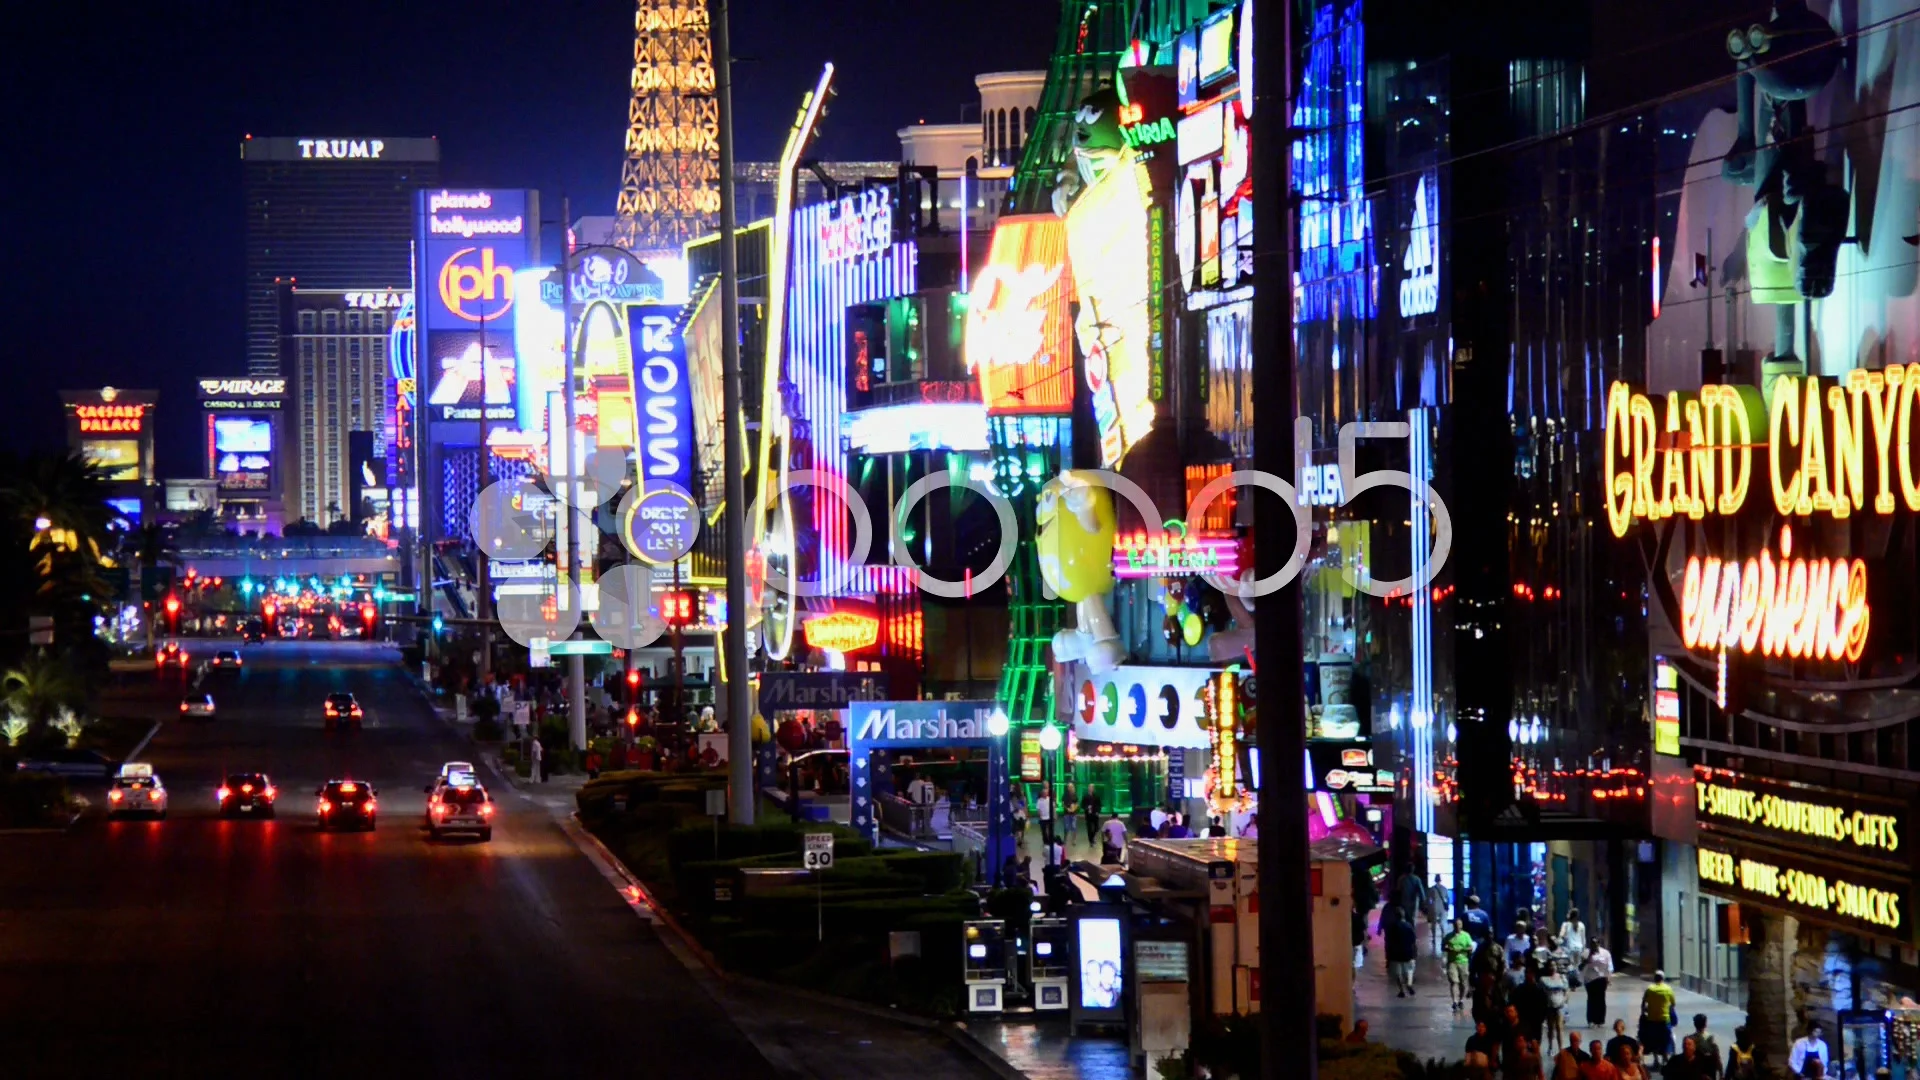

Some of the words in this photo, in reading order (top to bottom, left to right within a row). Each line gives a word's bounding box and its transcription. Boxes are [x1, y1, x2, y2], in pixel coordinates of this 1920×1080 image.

[298, 139, 384, 159] TRUMP
[430, 189, 491, 213] planet
[430, 215, 522, 238] hollywood
[449, 248, 514, 310] ph
[1151, 207, 1163, 332] MARGARITAS
[206, 379, 286, 396] MIRAGE
[1152, 351, 1163, 399] YARD
[203, 401, 238, 409] CASINO
[641, 315, 680, 476] ROSS
[76, 404, 144, 418] CAESARS
[444, 406, 516, 420] Panasonic
[81, 418, 142, 432] PALACE
[1605, 379, 1752, 538] GRAND
[764, 677, 888, 704] Marshalls
[856, 707, 992, 741] Marshall
[1763, 795, 1845, 842] SOUVENIRS
[1852, 811, 1899, 851] GIFTS
[808, 851, 831, 866] 30
[1698, 847, 1735, 885] BEER
[1740, 859, 1780, 899] WINE
[1786, 870, 1829, 911] SODA
[1835, 880, 1900, 929] SNACKS
